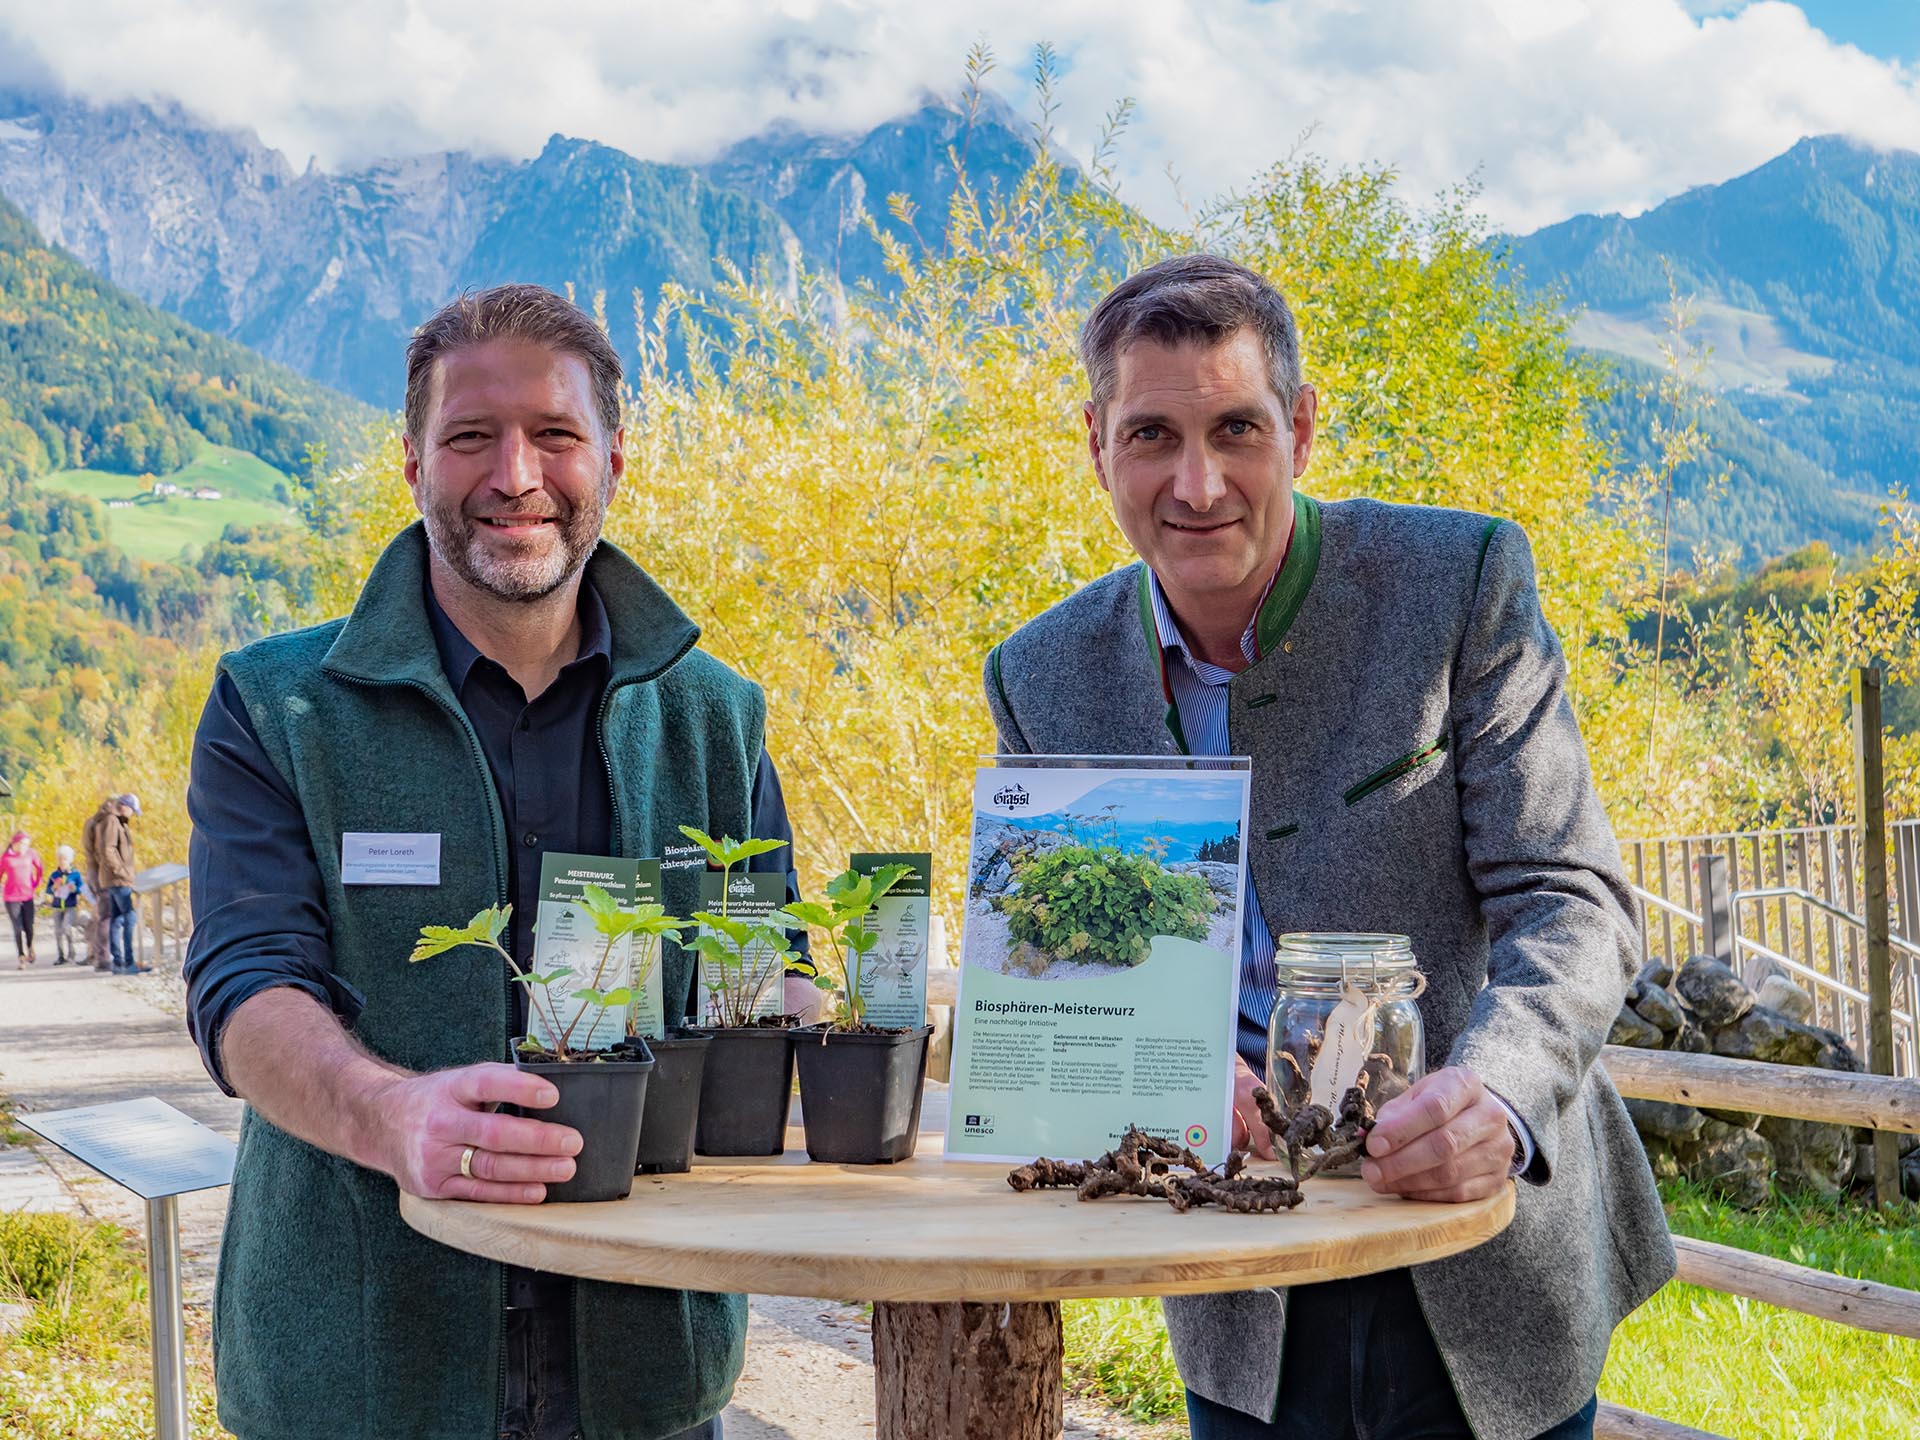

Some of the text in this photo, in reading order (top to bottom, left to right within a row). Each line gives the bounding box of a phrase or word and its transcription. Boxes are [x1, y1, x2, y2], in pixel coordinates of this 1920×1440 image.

[994, 792, 1030, 805] Grassl
[368, 848, 414, 856] Peter Loreth
[568, 870, 614, 880] MEISTERWURZ
[728, 883, 755, 894] Grassl
[975, 1000, 1135, 1016] Biosphären-Meisterwurz
[989, 1018, 1027, 1027] nachhaltige
